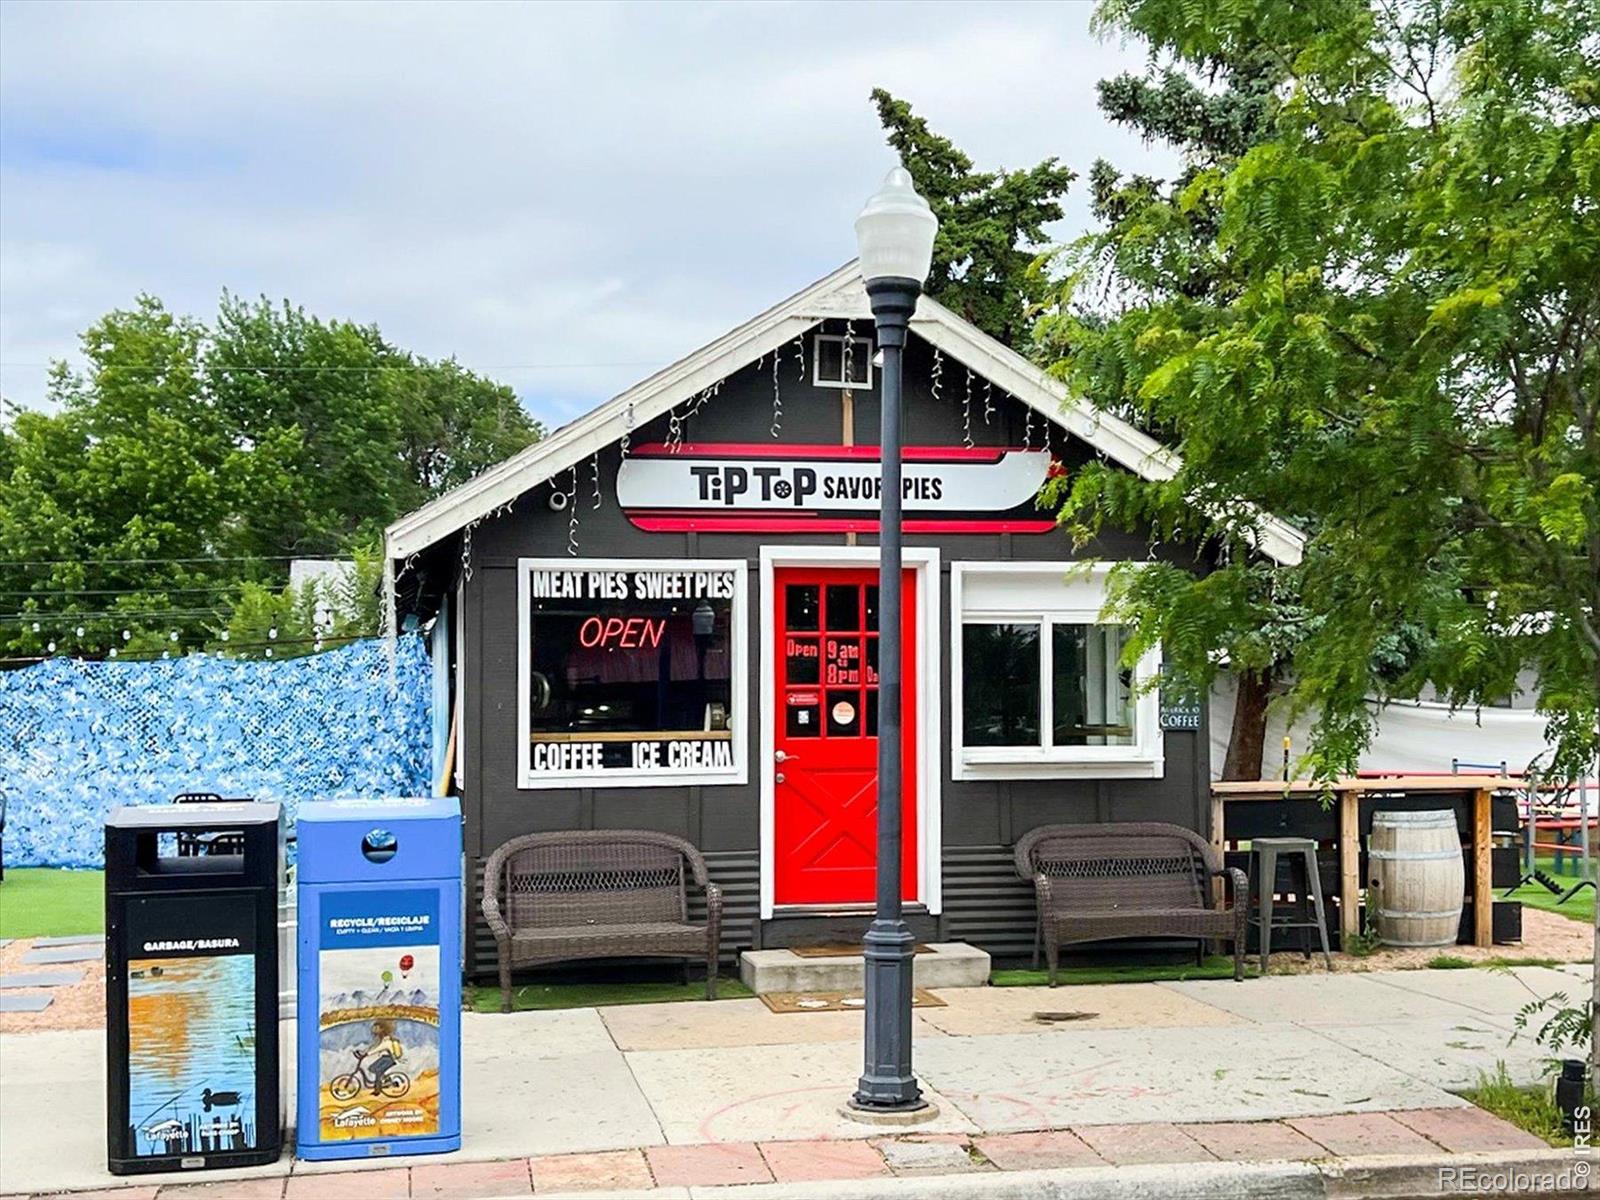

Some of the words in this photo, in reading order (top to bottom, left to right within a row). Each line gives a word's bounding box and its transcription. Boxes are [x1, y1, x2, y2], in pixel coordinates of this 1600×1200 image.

[823, 476, 882, 499] SAVOR
[902, 477, 943, 500] PIES
[533, 571, 584, 598] MEAT
[588, 572, 628, 599] PIES
[634, 573, 693, 599] SWEET
[695, 573, 735, 599] PIES
[580, 617, 666, 647] OPEN
[787, 639, 818, 657] Open
[534, 743, 603, 770] COFFEE
[632, 742, 660, 769] ICE
[668, 741, 732, 768] CREAM
[330, 916, 430, 928] RECYCLE/RECICLAJE
[143, 939, 240, 952] GARBAGE/BASURA
